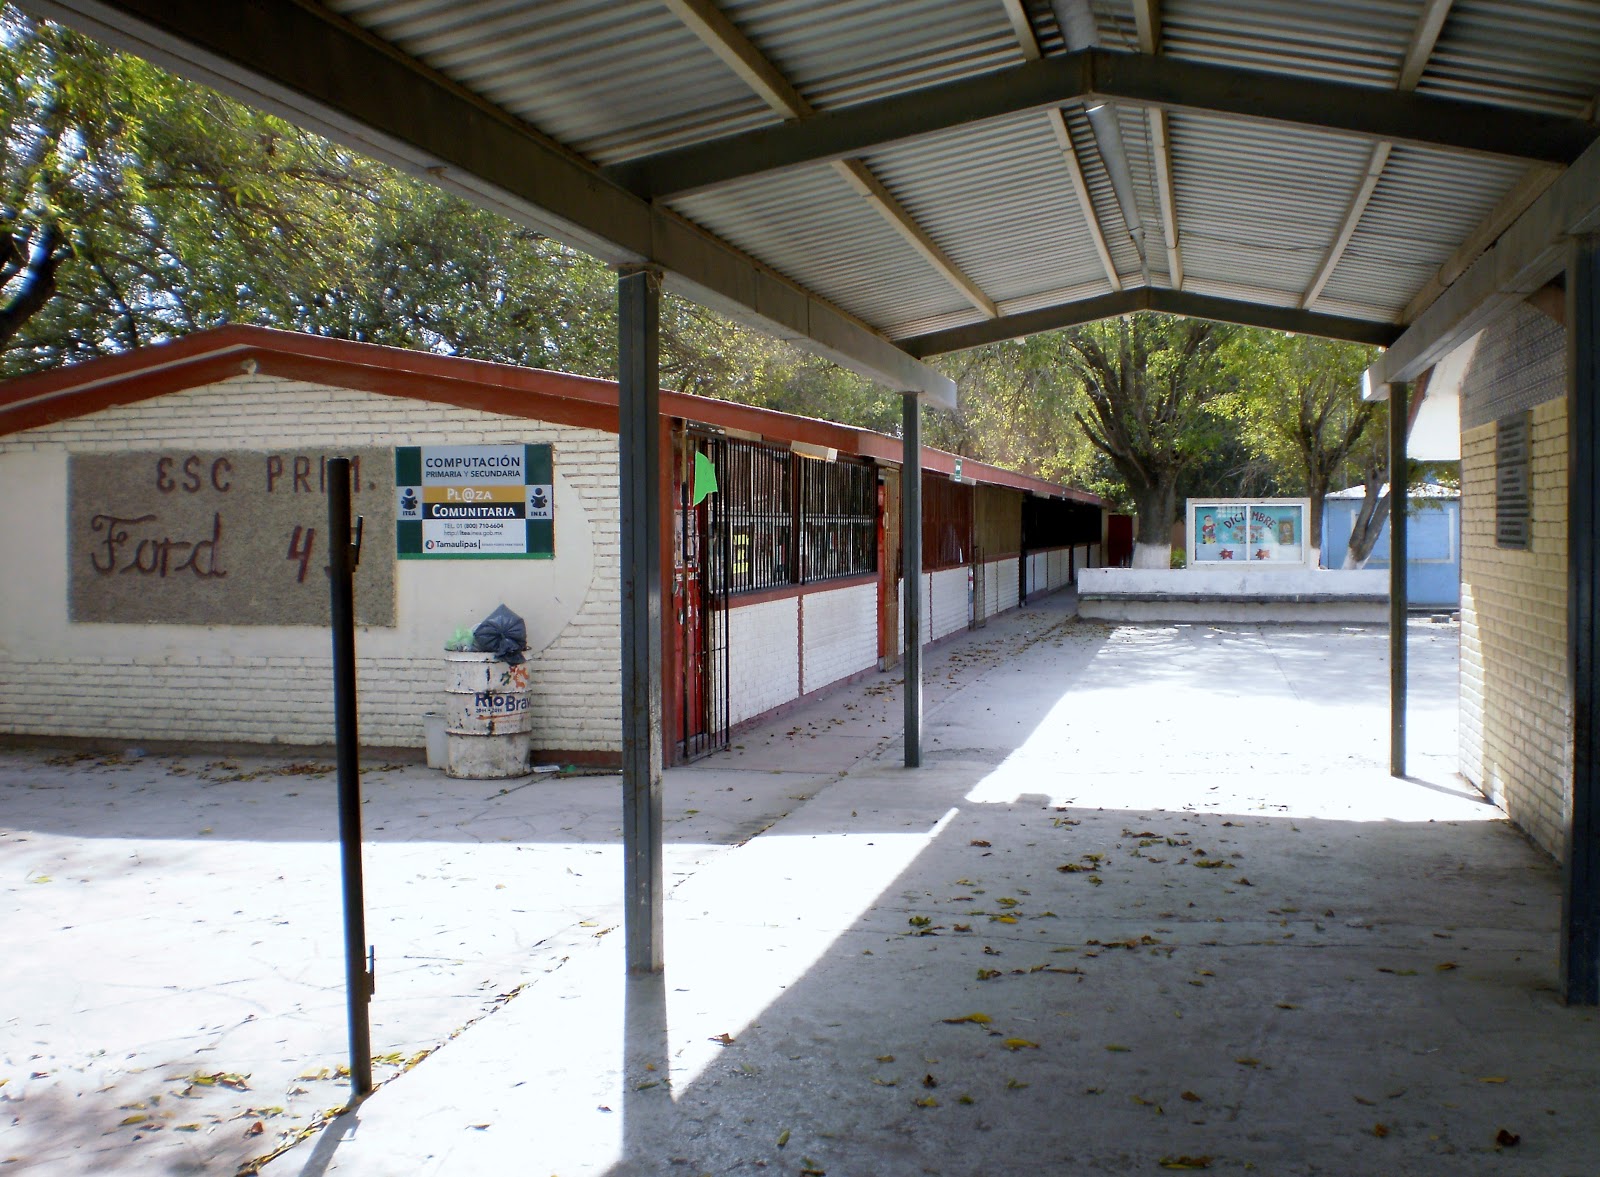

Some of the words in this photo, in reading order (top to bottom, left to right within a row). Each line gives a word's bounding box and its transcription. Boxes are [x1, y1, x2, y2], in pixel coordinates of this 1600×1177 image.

[425, 455, 521, 468] COMPUTACIÓN
[156, 454, 232, 493] ESC
[266, 454, 377, 493] PRI.
[425, 470, 462, 478] PRIMARIA
[470, 470, 521, 478] SECUNDARIA
[432, 504, 516, 517] COMUNITARIA
[1223, 510, 1277, 530] DICIMBRE
[91, 511, 227, 579] Ford
[436, 540, 478, 549] Tamaulipas
